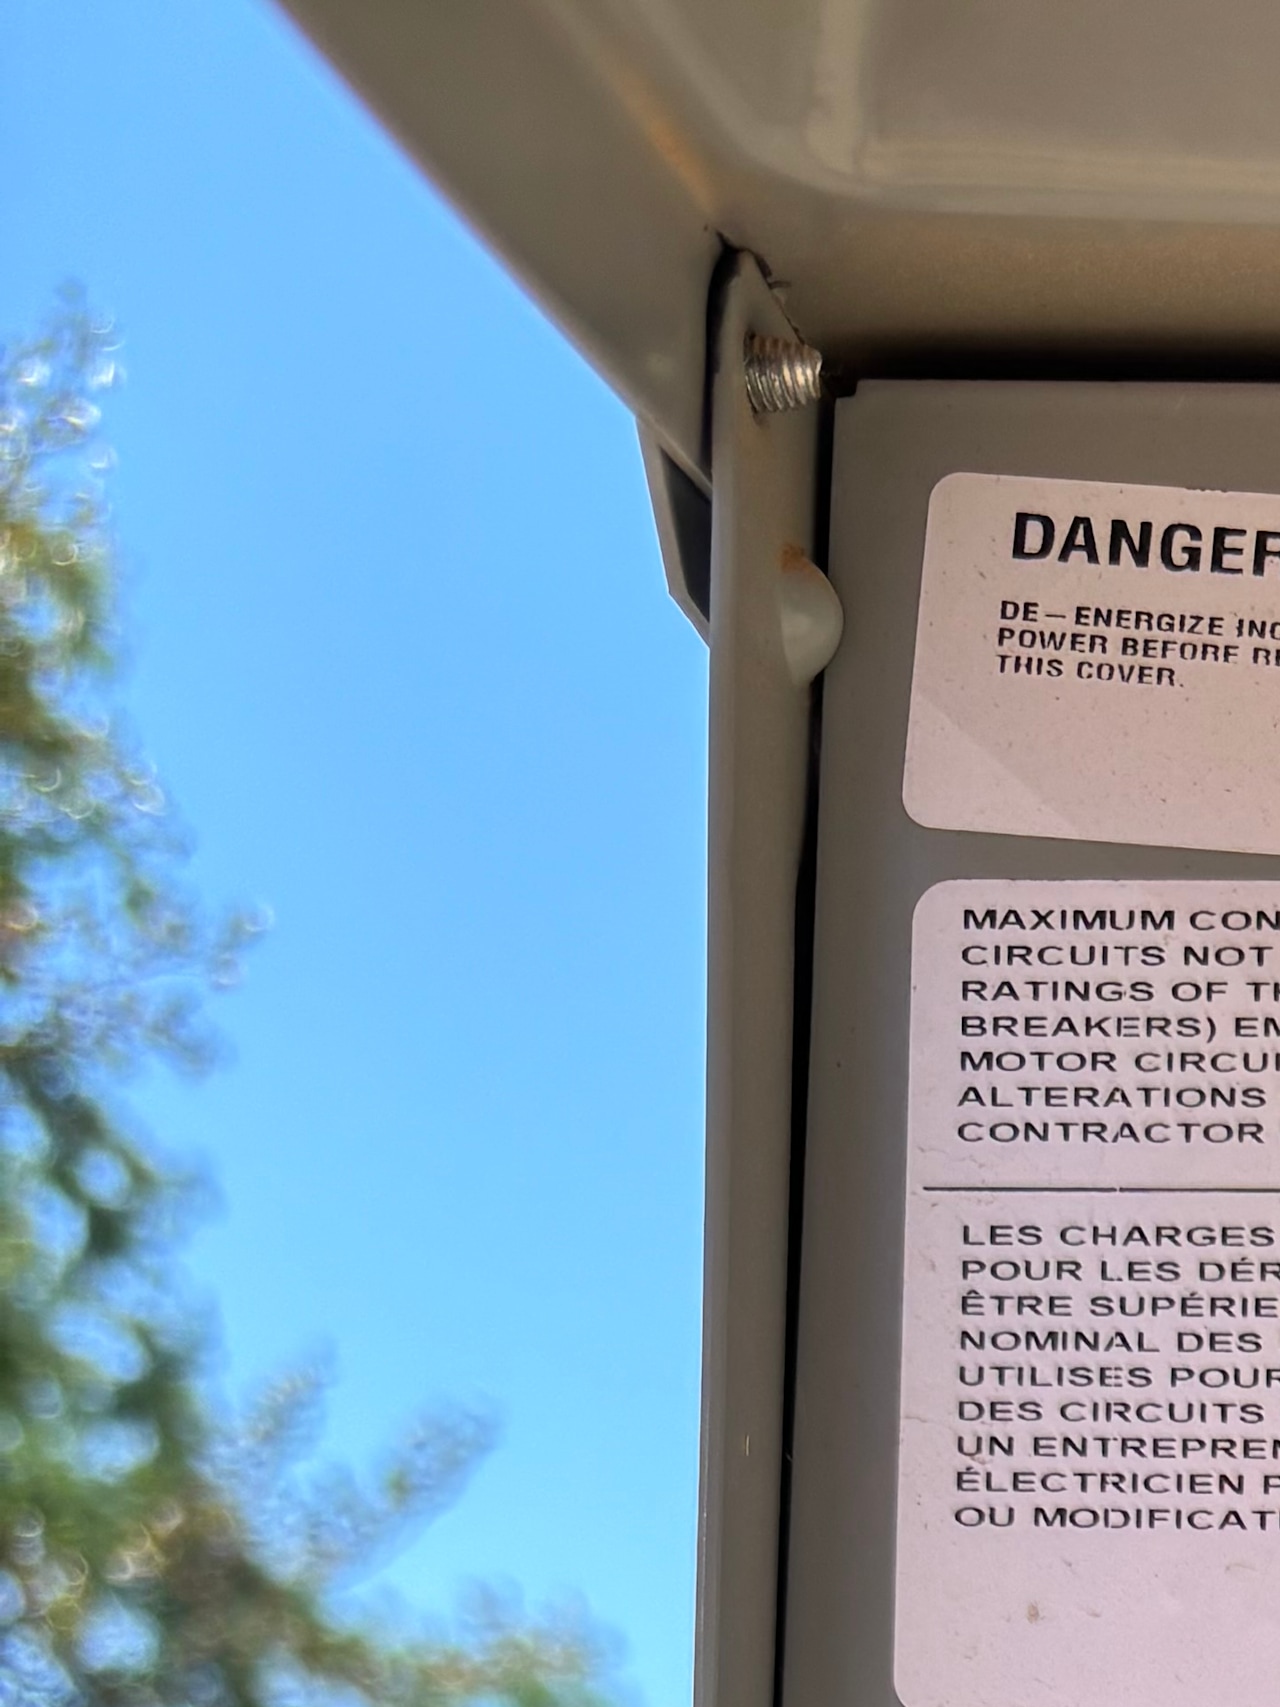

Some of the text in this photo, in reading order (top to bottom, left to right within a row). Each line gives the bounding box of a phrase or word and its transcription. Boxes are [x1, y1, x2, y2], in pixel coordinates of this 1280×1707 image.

[997, 626, 1108, 655] POWER
[1121, 636, 1240, 664] BEFORE
[997, 654, 1184, 688] THIS COVER.
[963, 908, 1176, 931] MAXIMUM
[961, 944, 1166, 967] CIRCUITS
[1183, 945, 1274, 967] NOT
[961, 980, 1154, 1002] RATINGS
[1171, 980, 1229, 1003] OF
[961, 1015, 1217, 1043] BREAKERS)
[960, 1050, 1117, 1073] MOTOR
[957, 1085, 1267, 1108] ALTERATIONS
[957, 1121, 1265, 1144] CONTRACTOR
[962, 1224, 1043, 1246] LES
[1059, 1224, 1275, 1247] CHARGES
[961, 1259, 1083, 1282] POUR
[1100, 1259, 1181, 1282] LES
[960, 1288, 1073, 1317] ÊTRE
[959, 1329, 1160, 1353] NOMINAL
[1176, 1331, 1263, 1353] DES
[953, 1506, 1015, 1528] OU
